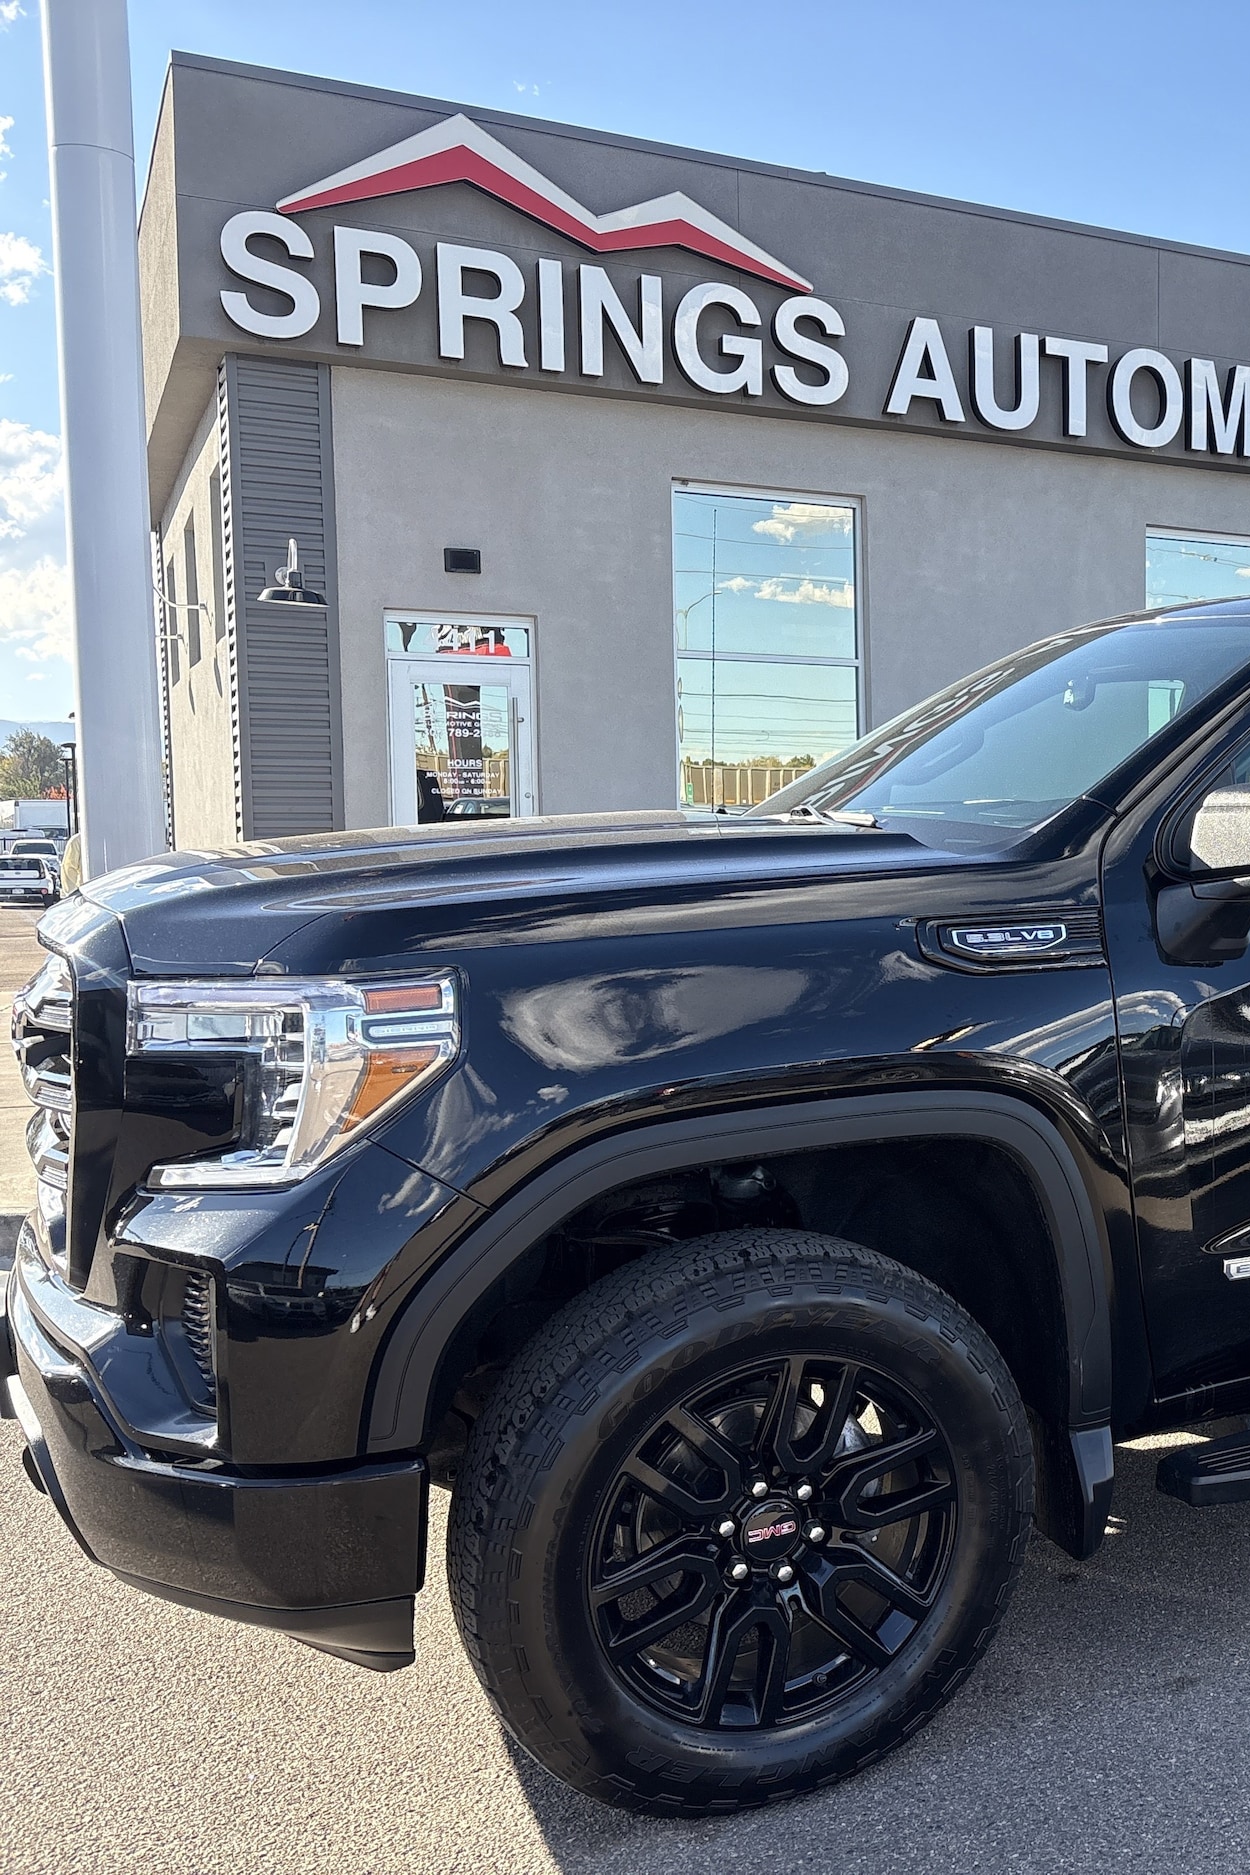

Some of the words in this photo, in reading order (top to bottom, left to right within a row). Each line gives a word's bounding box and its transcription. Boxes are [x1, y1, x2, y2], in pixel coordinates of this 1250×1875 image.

[218, 210, 849, 406] SPRINGS
[447, 759, 483, 768] HOURS
[426, 771, 457, 779] MONDAY
[462, 771, 501, 779] SATURDAY
[473, 788, 502, 796] SUNDAY
[598, 1307, 943, 1442] GOODYEAR
[747, 1520, 797, 1544] GMC
